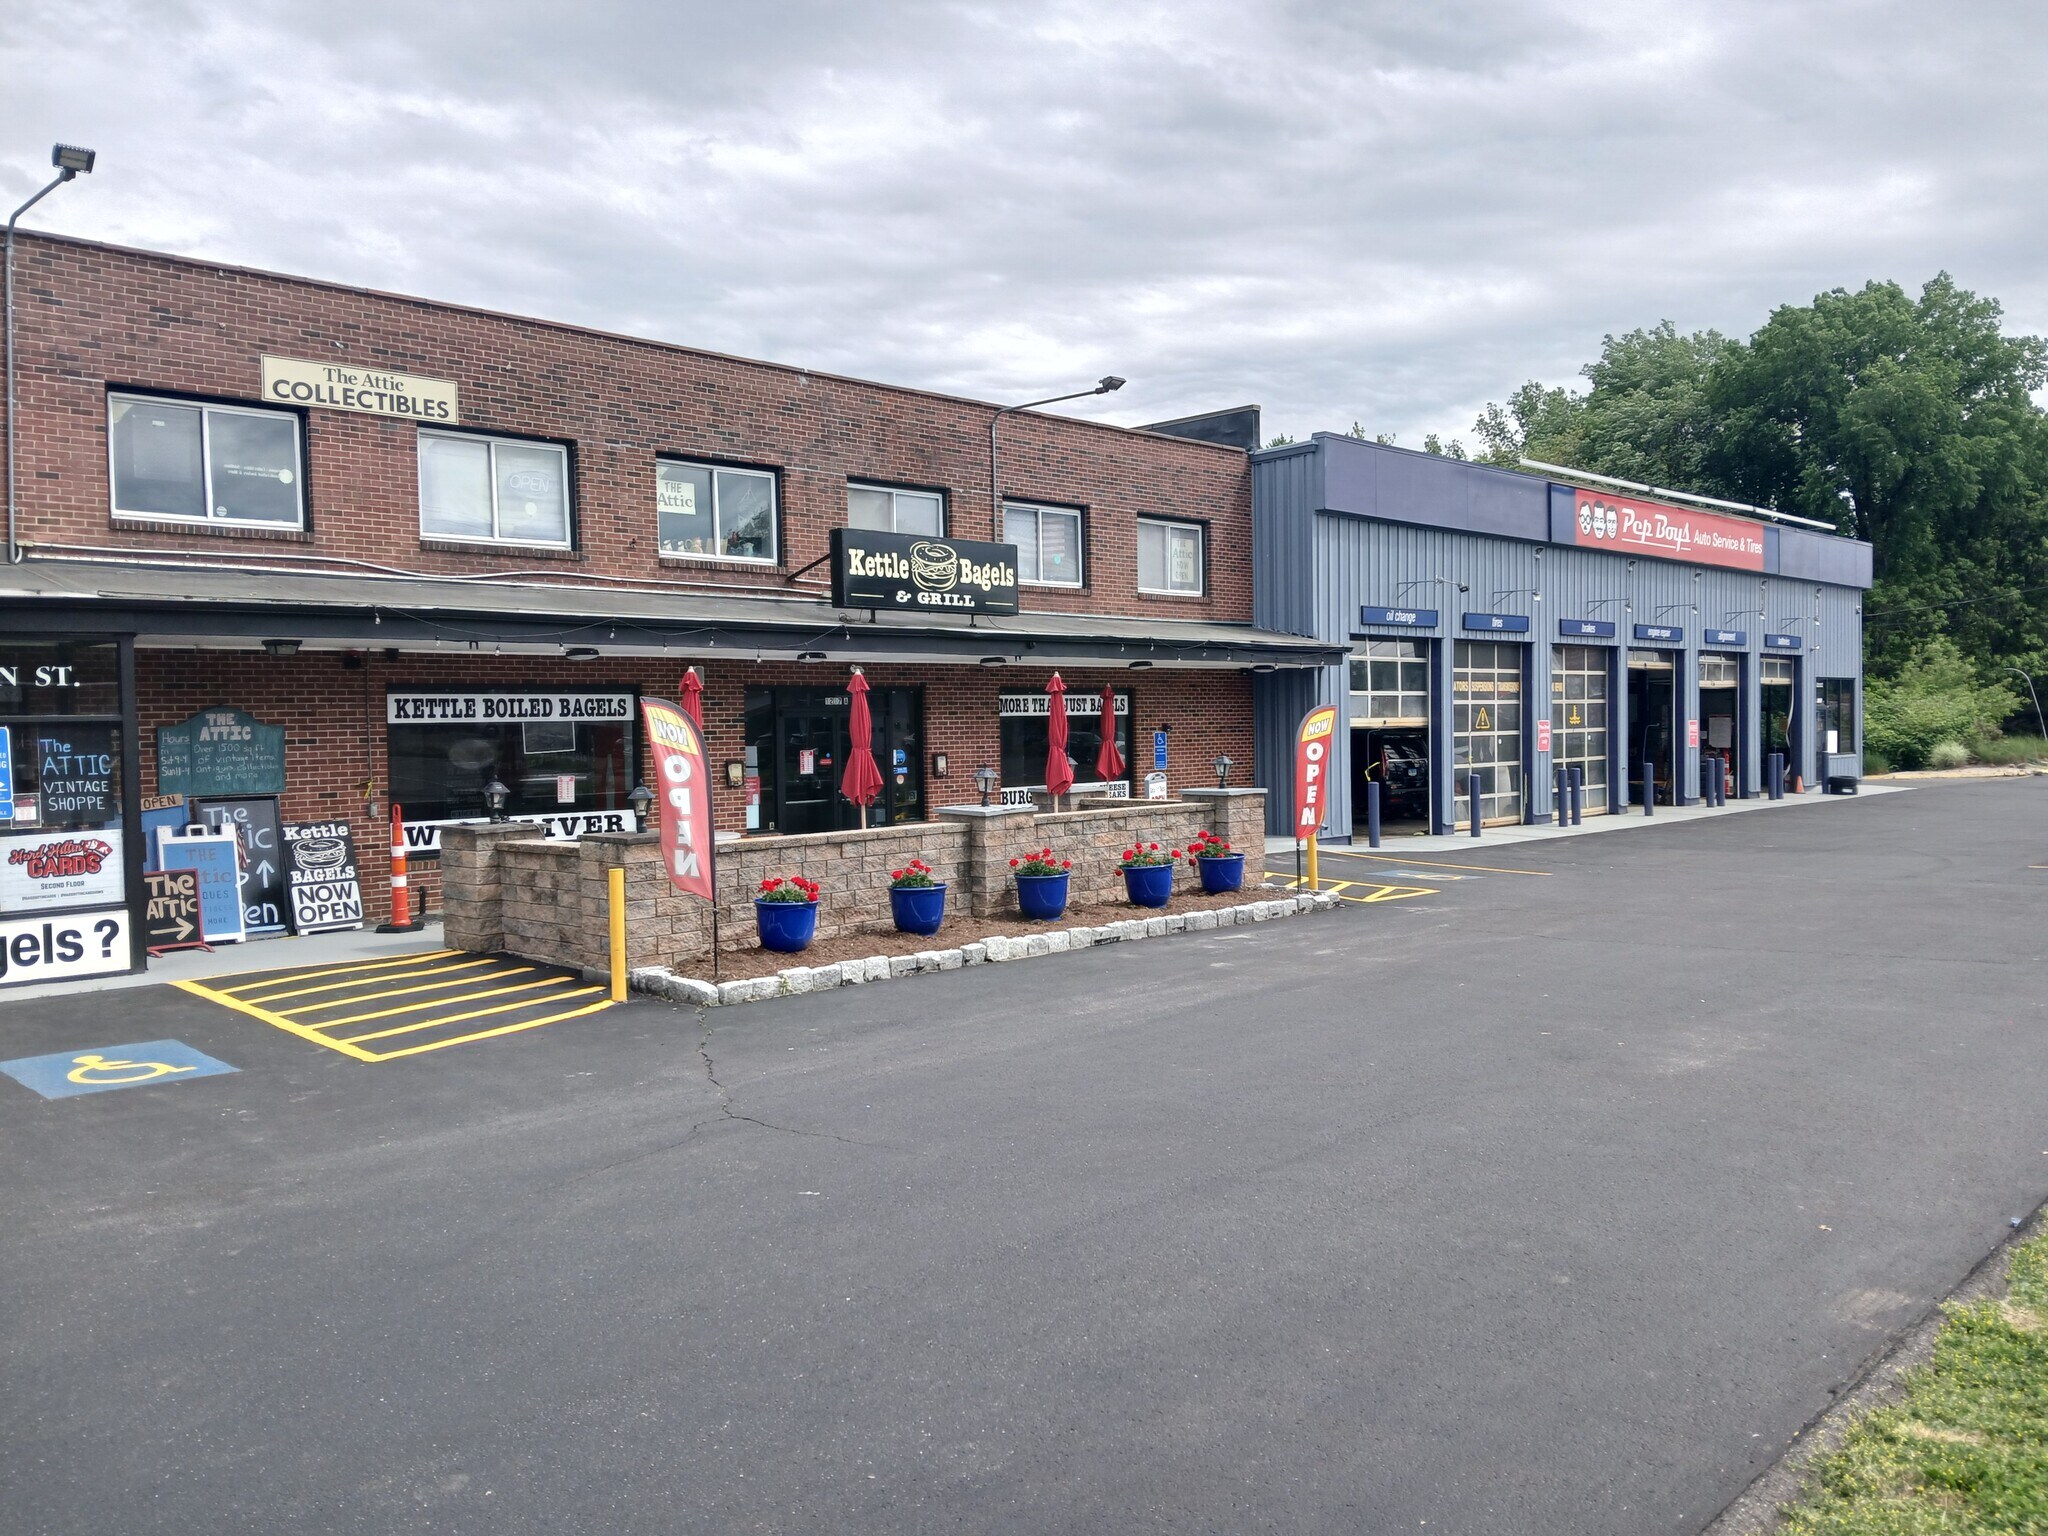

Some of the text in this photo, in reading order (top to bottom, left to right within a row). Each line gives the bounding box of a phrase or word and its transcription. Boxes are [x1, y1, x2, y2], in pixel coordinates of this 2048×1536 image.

[323, 367, 404, 392] The Attic
[272, 379, 449, 419] COLLECTIBLES
[510, 474, 549, 492] OPEN
[664, 482, 682, 493] THE
[658, 492, 693, 508] Attic
[1621, 508, 1762, 554] Pep Boys Auto Service & Tires
[848, 548, 1014, 591] Kettle Bagels
[896, 590, 975, 607] & GRILL
[1386, 610, 1416, 624] oil change
[1492, 617, 1504, 628] tires
[35, 666, 80, 686] ST.
[394, 698, 628, 718] KETTLE BOILED BAGELS
[1000, 698, 1126, 713] MORE THA JUST BALS
[206, 713, 235, 726] THE
[1307, 718, 1330, 736] NOW
[162, 732, 190, 744] Hours
[200, 726, 252, 741] ATTIC
[40, 738, 72, 753] The
[194, 744, 214, 754] Over
[218, 744, 240, 752] 1500
[43, 754, 110, 776] ATTIC
[216, 772, 232, 782] and
[1300, 742, 1324, 826] OPEN
[44, 780, 109, 794] VINTAGE
[48, 796, 106, 812] SHOPPE
[143, 796, 176, 810] OPEN
[203, 806, 248, 826] The
[282, 824, 348, 840] Kettle
[513, 814, 625, 838] IVER
[186, 848, 216, 862] THE
[27, 853, 102, 878] CARDS
[199, 868, 232, 884] tic
[290, 866, 356, 884] BAGELS
[40, 881, 64, 890] SECOND
[144, 874, 195, 898] The
[298, 882, 352, 904] NOW
[298, 900, 360, 923] OPEN
